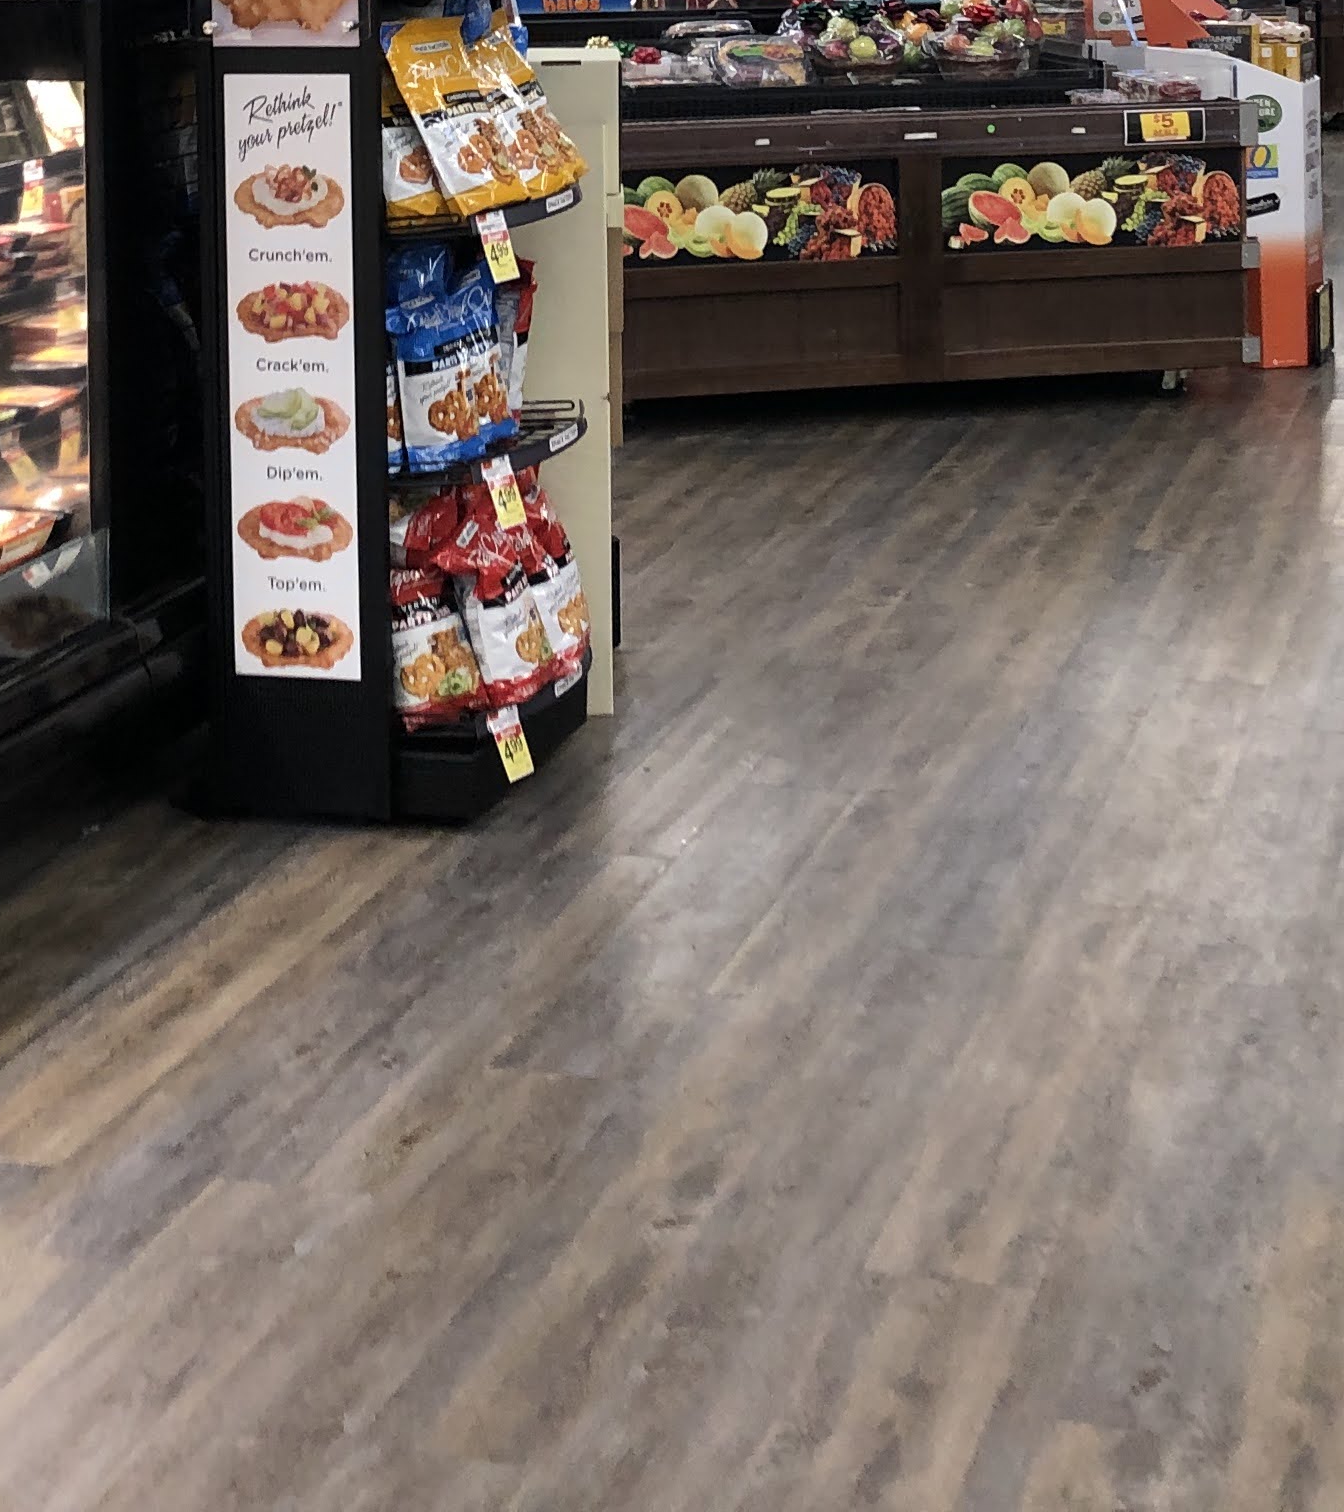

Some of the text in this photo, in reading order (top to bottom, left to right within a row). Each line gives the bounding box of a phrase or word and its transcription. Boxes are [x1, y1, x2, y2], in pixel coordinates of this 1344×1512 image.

[243, 85, 315, 125] Rethink
[1153, 112, 1174, 128] $5
[238, 127, 273, 162] your
[249, 248, 333, 262] Crunch'em.
[256, 357, 330, 375] Crack'em.
[266, 466, 323, 483] Dip'em.
[268, 576, 327, 592] Top'em.
